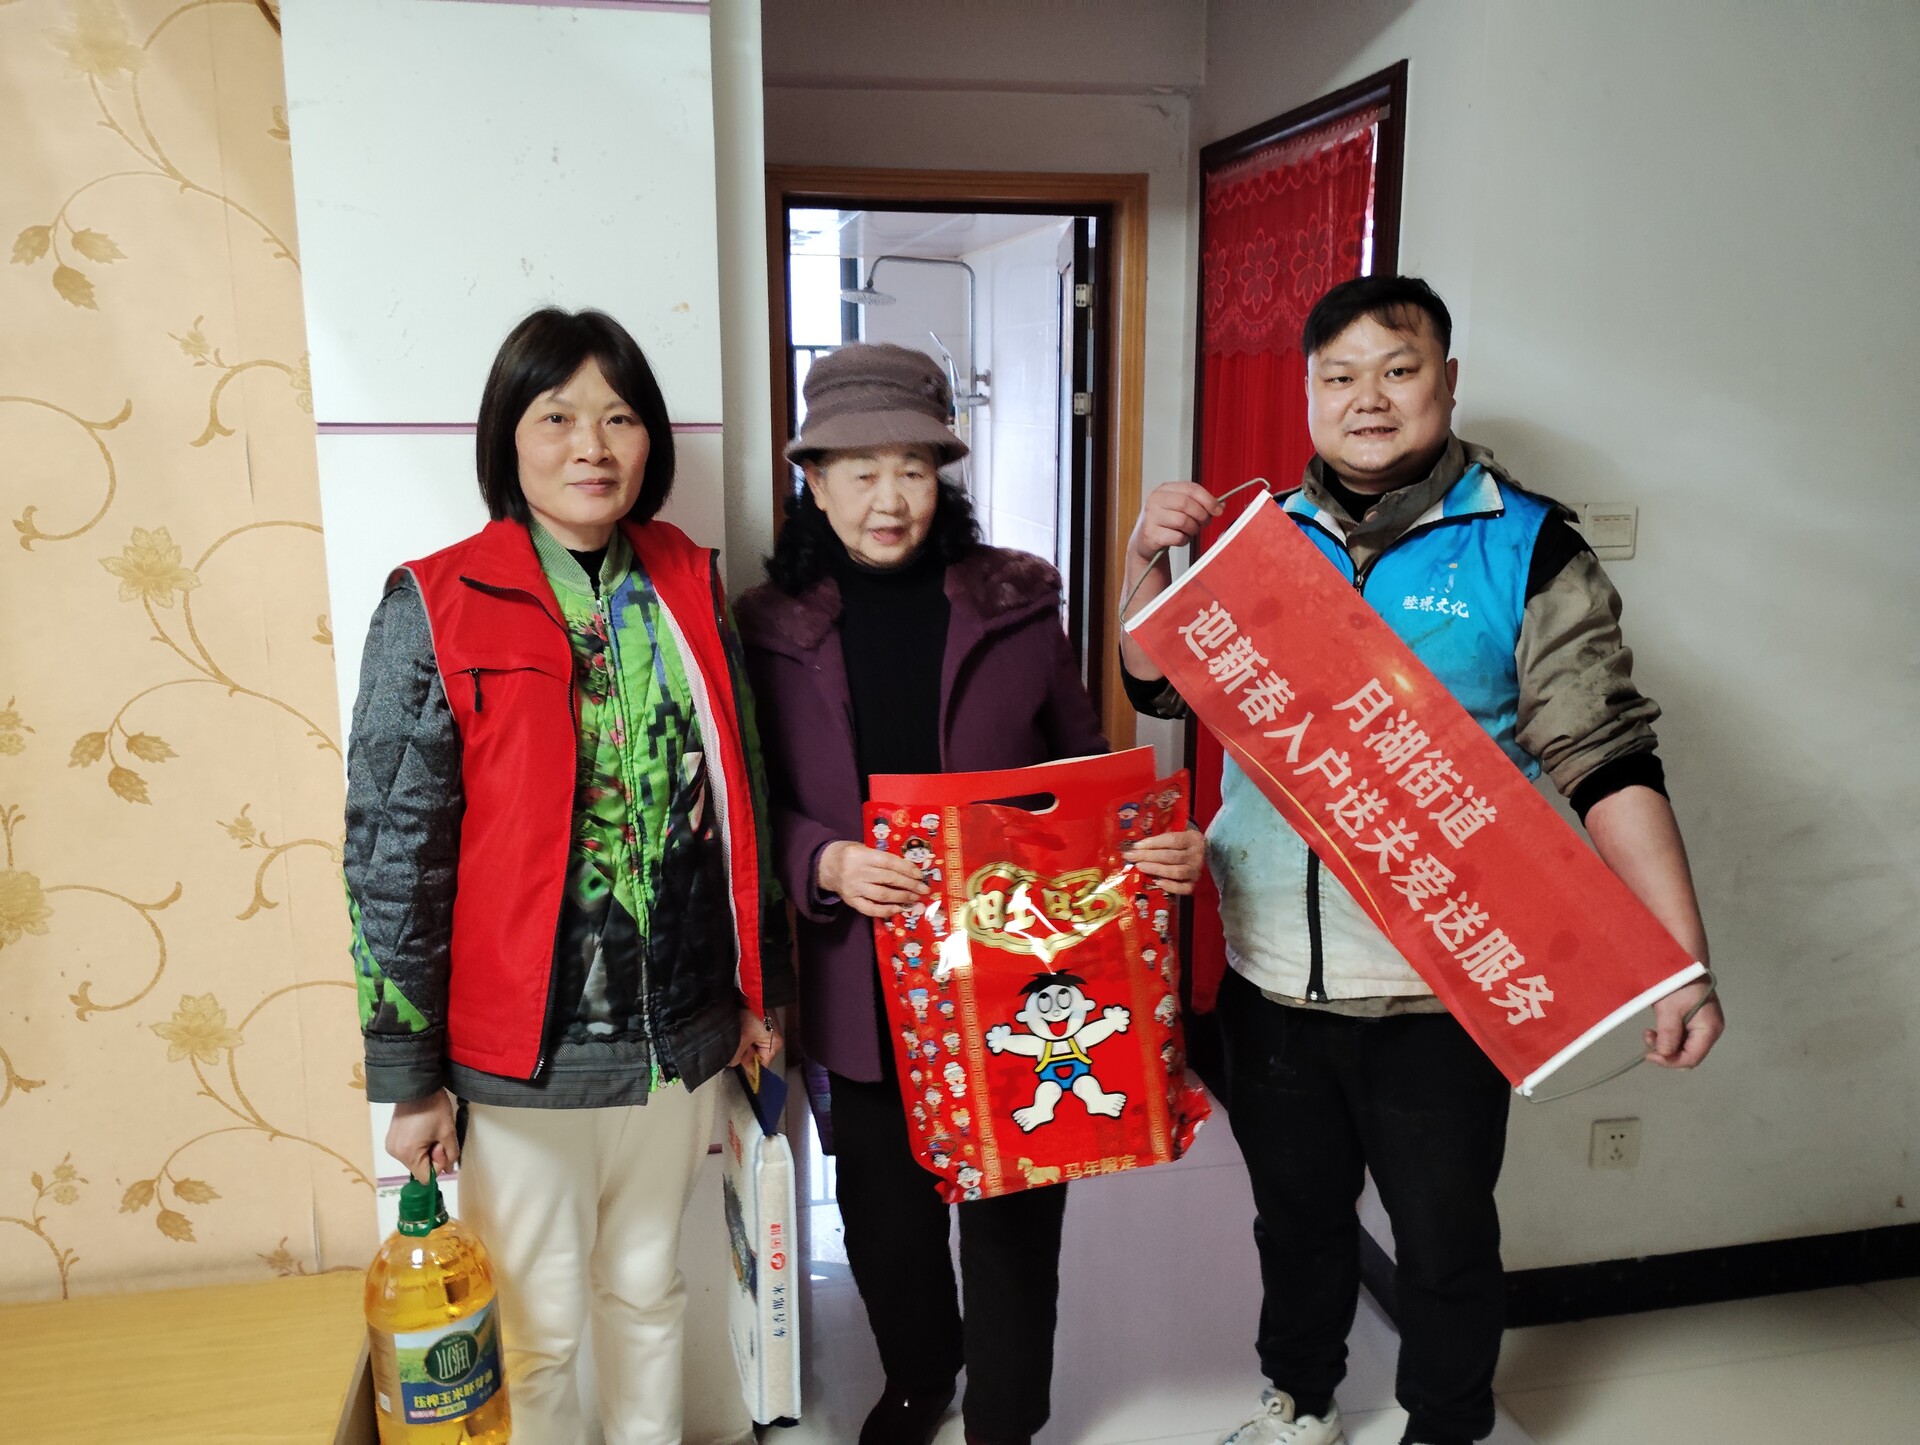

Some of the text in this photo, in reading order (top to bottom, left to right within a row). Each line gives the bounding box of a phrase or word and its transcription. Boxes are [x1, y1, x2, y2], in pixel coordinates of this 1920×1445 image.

[1177, 601, 1555, 1026] 迎新春入户送关爱送服务
[1333, 678, 1496, 849] 月湖街道
[1063, 1153, 1137, 1180] 马年限定
[435, 1340, 471, 1380] 山润
